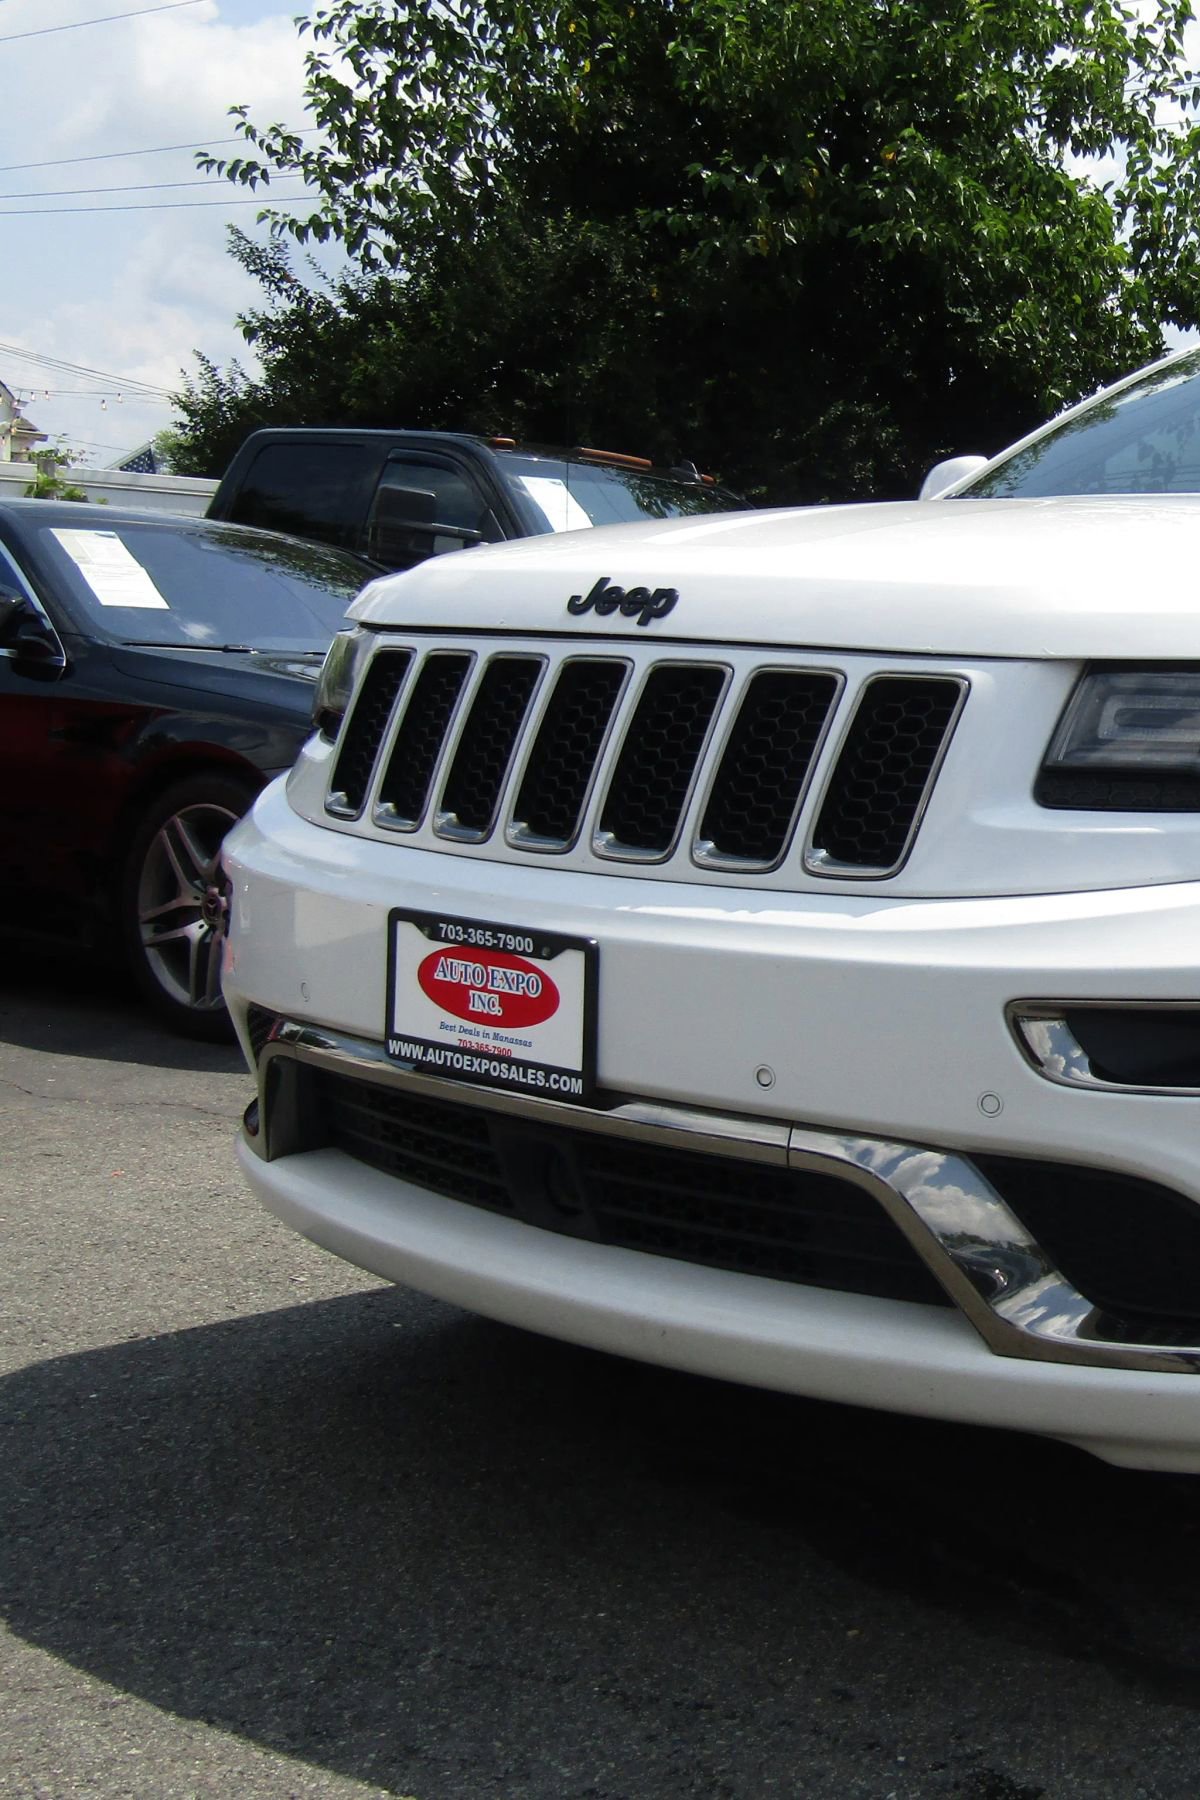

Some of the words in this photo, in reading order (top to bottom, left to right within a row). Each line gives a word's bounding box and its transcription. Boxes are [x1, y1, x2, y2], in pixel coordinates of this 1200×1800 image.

[567, 577, 679, 626] Jeep
[439, 923, 534, 953] 703-365-7900
[435, 957, 487, 987] AUTO
[489, 966, 542, 998] EXPO
[469, 990, 503, 1015] INC.
[440, 1021, 456, 1033] Best
[458, 1025, 480, 1037] Deals
[482, 1029, 490, 1039] in
[492, 1031, 533, 1047] Manassas
[457, 1039, 512, 1057] 703-365-7900
[388, 1039, 583, 1094] WWW.AUTOEXPOSALES.COM
